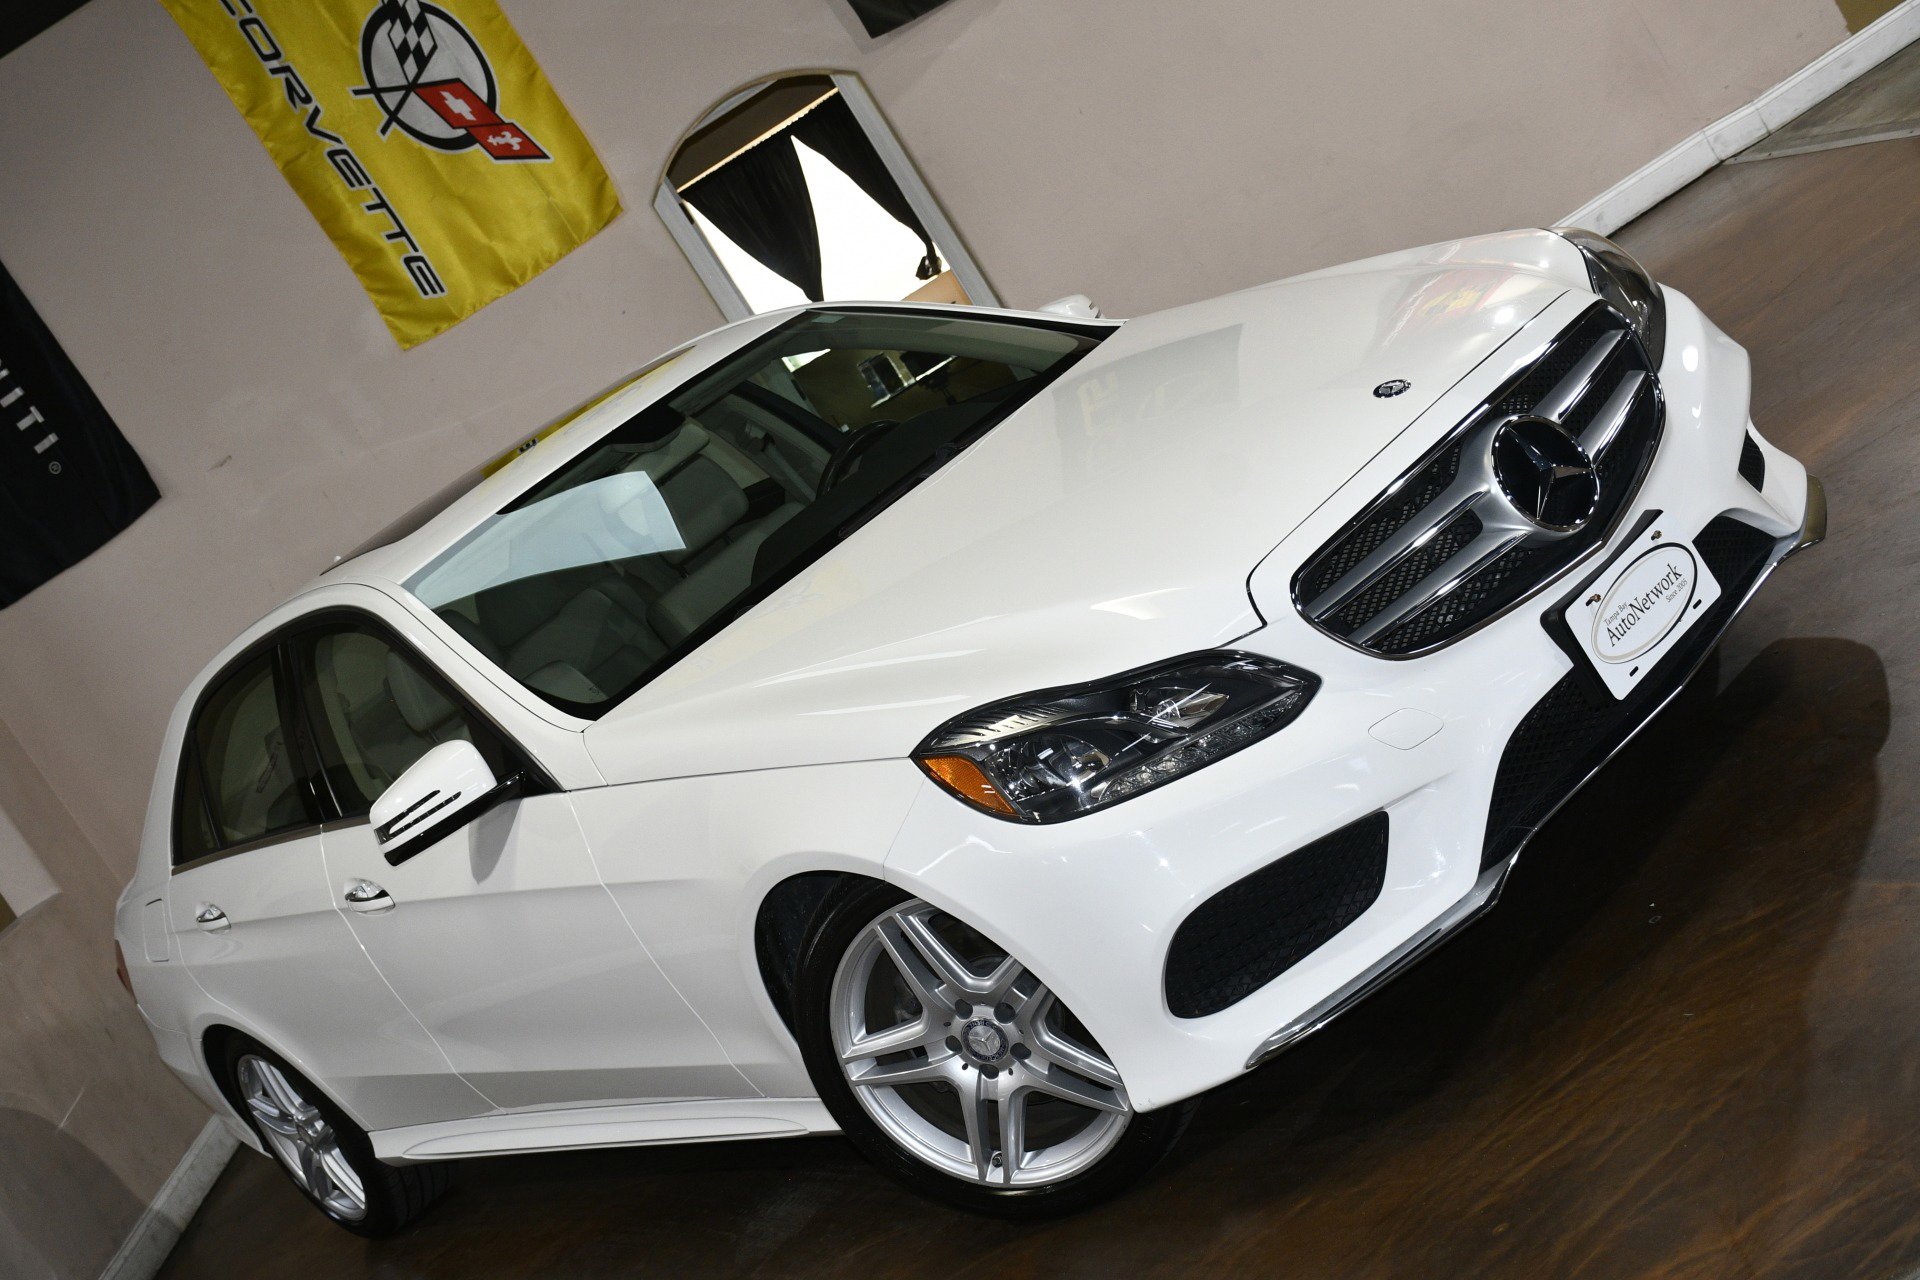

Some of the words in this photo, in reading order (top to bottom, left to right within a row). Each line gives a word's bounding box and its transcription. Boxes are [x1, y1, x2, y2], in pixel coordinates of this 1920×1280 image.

[1606, 563, 1683, 648] AutoNetwork
[1665, 590, 1678, 603] Since
[1604, 611, 1620, 626] Tampa
[1617, 601, 1628, 613] Bay
